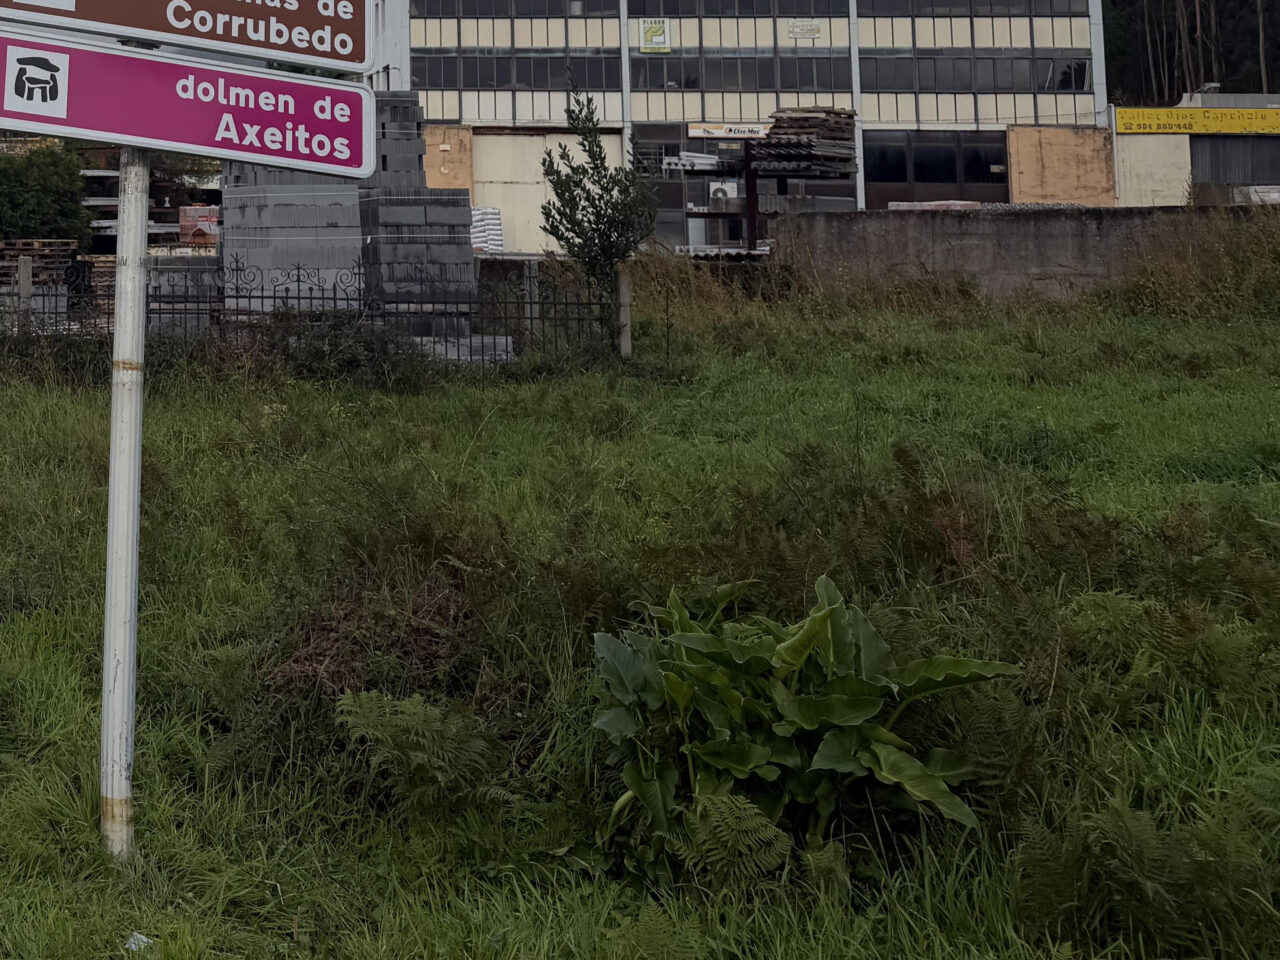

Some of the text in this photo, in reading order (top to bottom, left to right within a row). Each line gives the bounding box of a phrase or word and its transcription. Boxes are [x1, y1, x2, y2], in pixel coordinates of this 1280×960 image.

[176, 75, 352, 123] dolmen de
[215, 113, 352, 160] Axeitos
